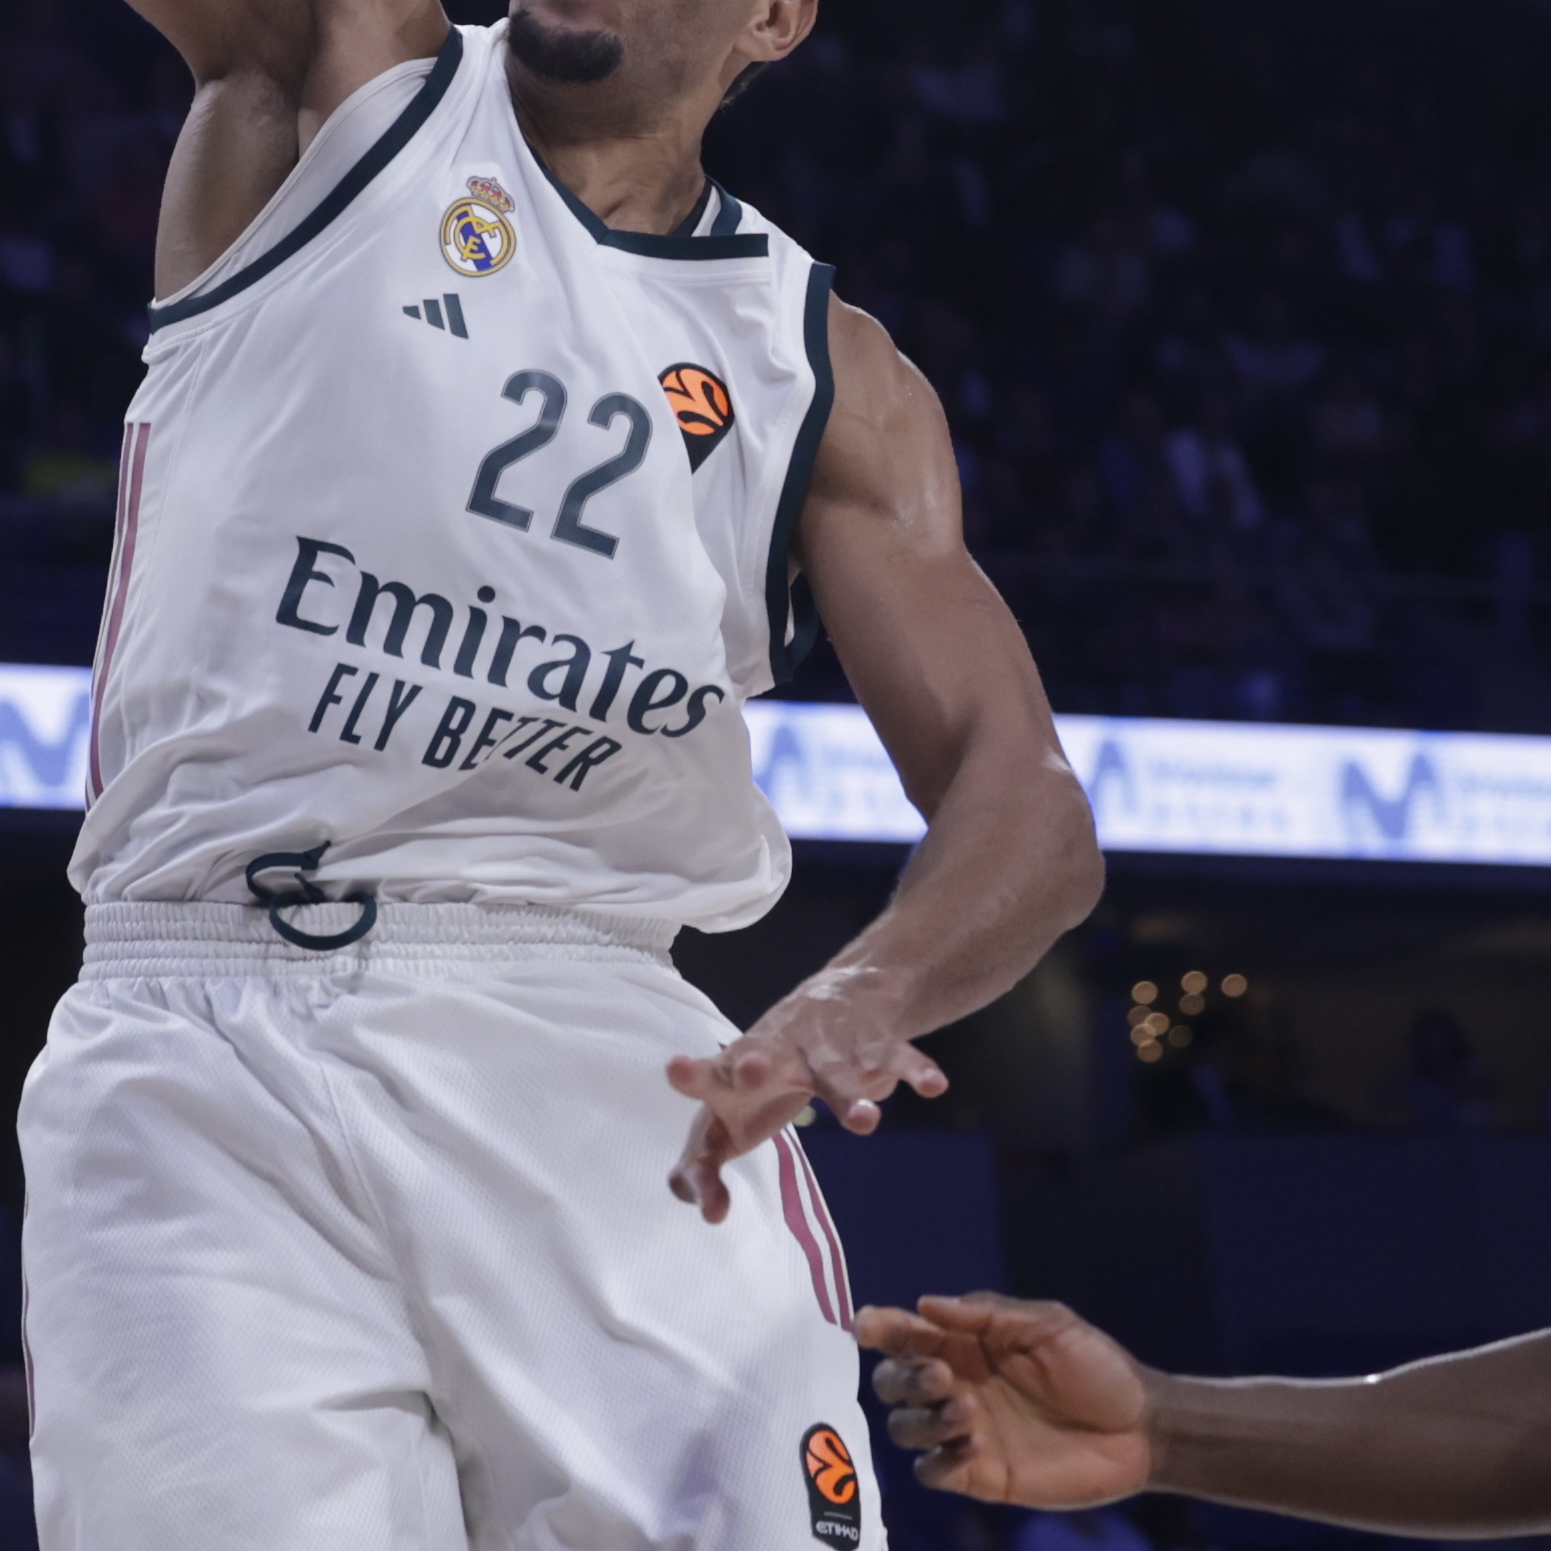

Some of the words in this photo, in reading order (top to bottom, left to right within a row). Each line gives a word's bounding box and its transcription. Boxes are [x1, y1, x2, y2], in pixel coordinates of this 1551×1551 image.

[465, 369, 653, 561] 22
[276, 536, 726, 738] Emirates
[308, 662, 423, 751] FLY
[422, 696, 623, 792] BETTER
[816, 1520, 859, 1541] ETIHAD
